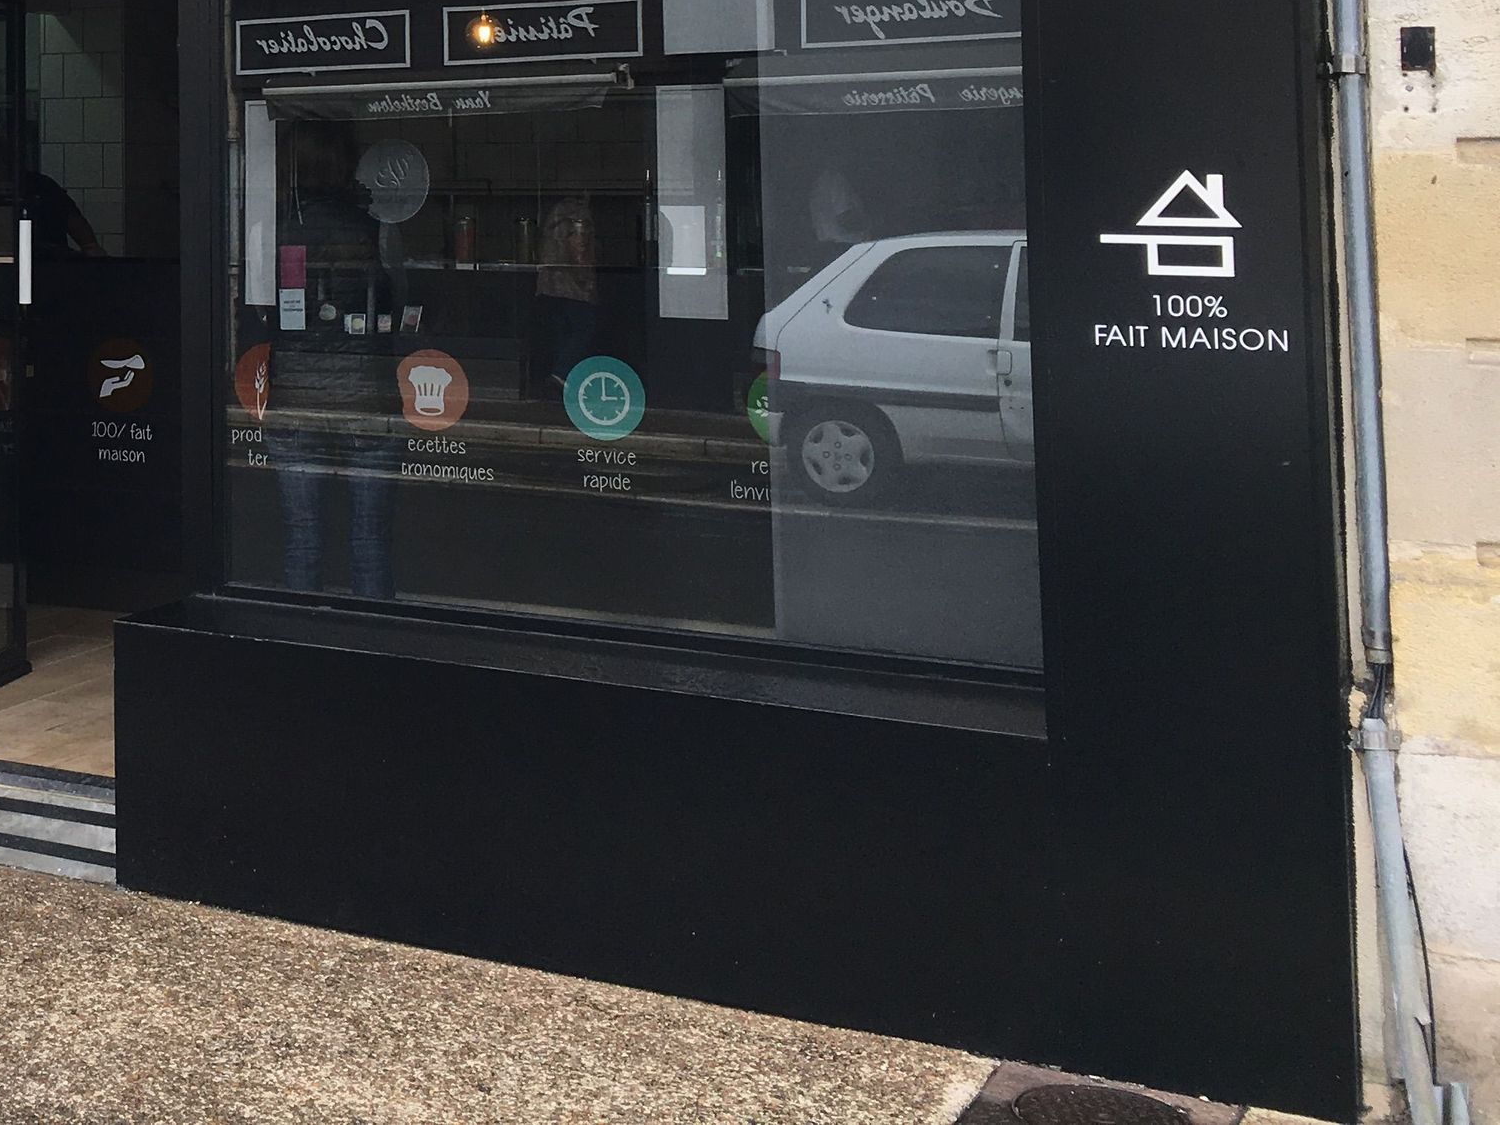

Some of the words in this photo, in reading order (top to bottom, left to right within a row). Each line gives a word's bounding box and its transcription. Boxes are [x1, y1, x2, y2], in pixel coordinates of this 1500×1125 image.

[1152, 294, 1228, 318] 100%
[1094, 324, 1149, 348] FAIT
[1161, 326, 1289, 352] MAISON
[129, 424, 153, 442] fait
[98, 448, 146, 464] maison
[577, 447, 637, 467] service
[583, 473, 632, 492] rapide
